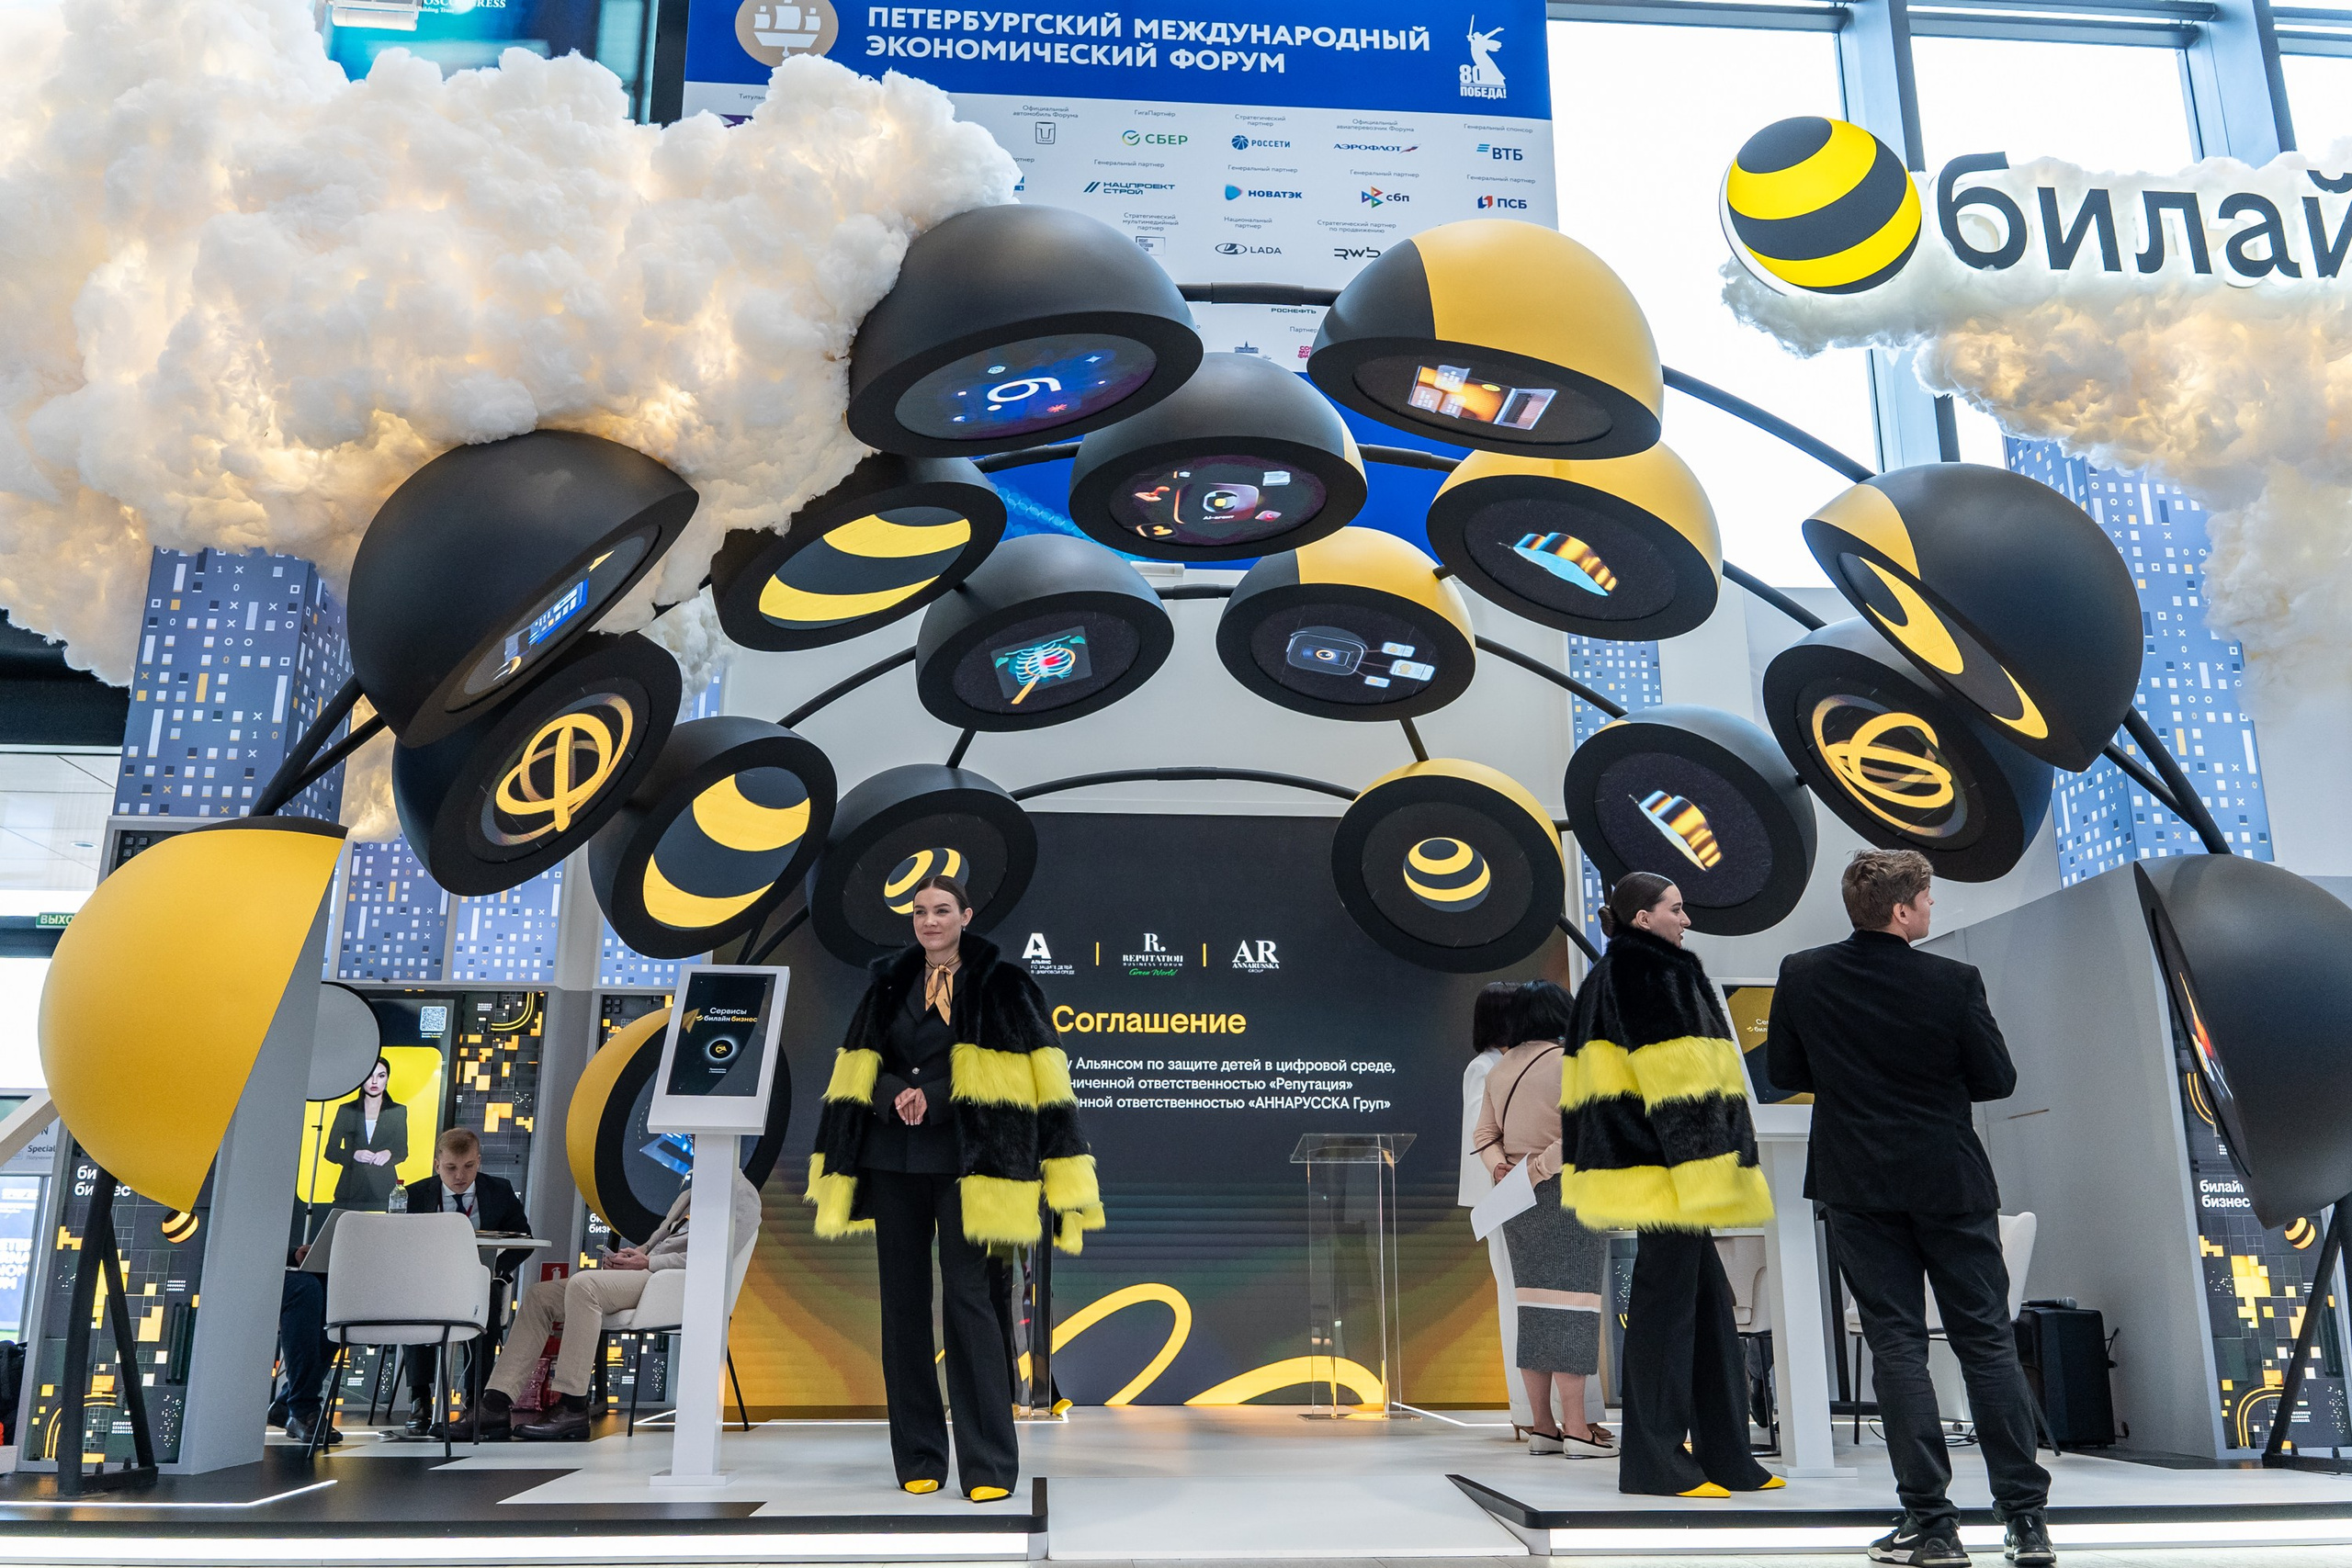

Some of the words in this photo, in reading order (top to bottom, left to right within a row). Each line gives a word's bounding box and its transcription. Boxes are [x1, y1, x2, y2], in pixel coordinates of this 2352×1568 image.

[869, 6, 1122, 38] ПЕТЕРБУРГСКИЙ
[1134, 17, 1430, 51] МЕЖДУНАРОДНЫЙ
[865, 35, 1157, 68] ЭКОНОМИЧЕСКИЙ
[1170, 50, 1285, 73] ФОРУМ
[1460, 86, 1507, 99] ПОБЕДА!
[1145, 134, 1188, 145] СБЕР
[1251, 140, 1291, 149] РОССЕТИ
[1334, 143, 1402, 152] АЭРОФЛОТ
[1492, 148, 1523, 161] ВТБ
[1103, 182, 1176, 191] НАЦПРОЕКТ
[1249, 190, 1303, 199] НОВАТЭК
[1386, 193, 1410, 202] сбп
[1498, 198, 1527, 209] ПСБ
[1250, 246, 1282, 254] LADA
[1232, 940, 1280, 964] AR
[1123, 954, 1183, 963] REPUTATION
[1129, 968, 1149, 976] Green
[1151, 968, 1178, 976] World
[1052, 1005, 1247, 1034] Соглашение
[1076, 1057, 1144, 1070] Альянсом
[1148, 1060, 1164, 1070] по
[1168, 1060, 1218, 1072] защите
[1221, 1059, 1261, 1073] детей
[1265, 1062, 1272, 1071] в
[1276, 1058, 1348, 1074] цифровой
[1351, 1062, 1396, 1074] среде,
[1138, 1079, 1266, 1090] ответственностью
[1270, 1077, 1353, 1093] «Репутация»
[1116, 1099, 1246, 1109] ответственностью
[1249, 1096, 1350, 1110] «АННАРУССКА
[1353, 1097, 1391, 1112] Груп»
[2201, 1195, 2251, 1208] бизнес
